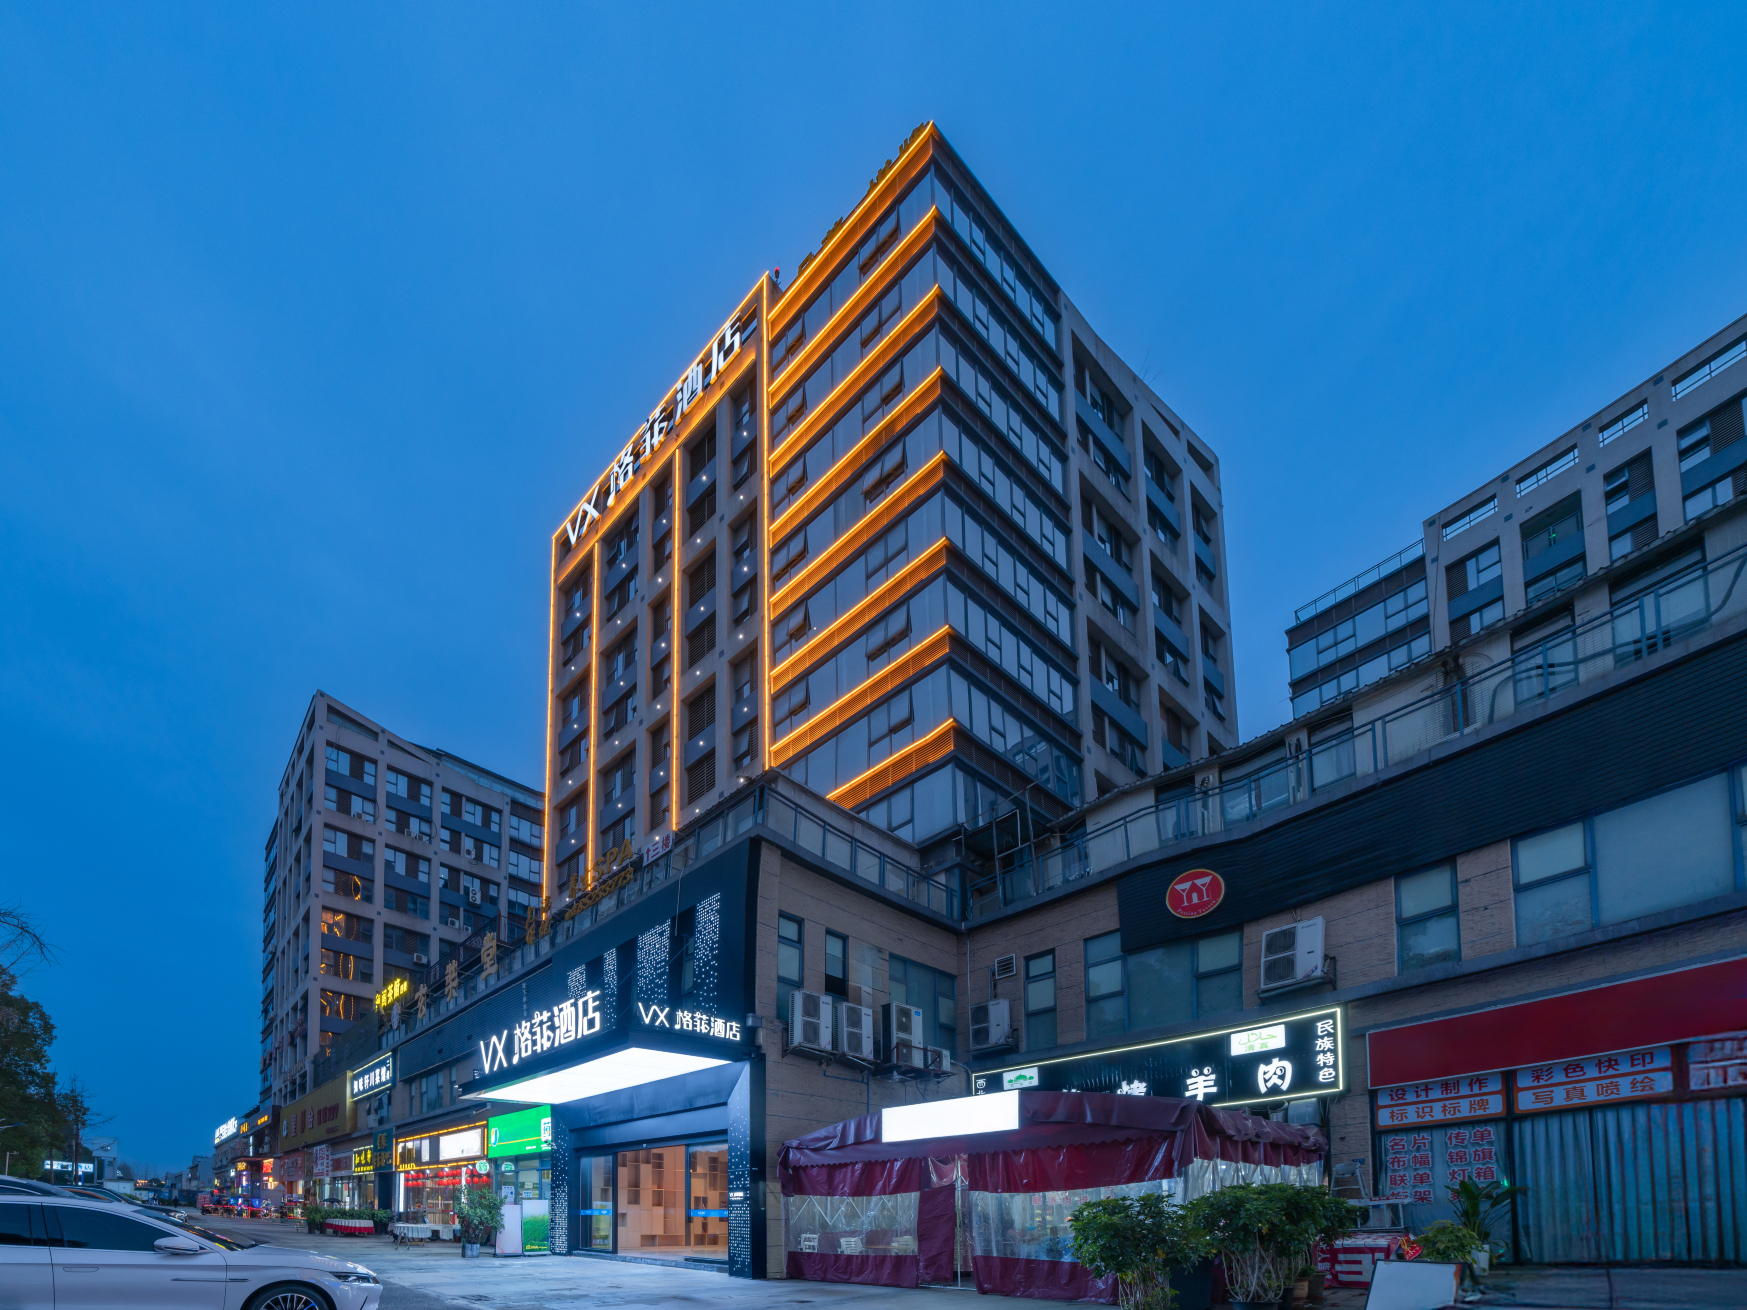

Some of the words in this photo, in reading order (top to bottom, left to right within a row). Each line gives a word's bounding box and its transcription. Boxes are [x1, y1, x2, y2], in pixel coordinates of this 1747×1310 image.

[566, 485, 601, 548] VX
[652, 833, 671, 859] 三楼
[638, 1002, 670, 1027] VX
[1238, 1031, 1278, 1046] حلال
[1244, 1042, 1270, 1052] 清真
[1315, 1019, 1336, 1082] 民族特色
[480, 1029, 507, 1074] VX
[1531, 1051, 1655, 1084] 彩色快印
[1388, 1077, 1489, 1103] 设计制作
[1531, 1076, 1656, 1106] 写真喷绘
[1389, 1098, 1491, 1123] 标识标牌
[1387, 1134, 1431, 1151] 名片
[1446, 1127, 1494, 1146] 传单
[1388, 1152, 1431, 1169] 布幅
[1447, 1147, 1495, 1164] 锦旗
[1388, 1171, 1432, 1187] 联单
[1448, 1165, 1495, 1183] 灯箱
